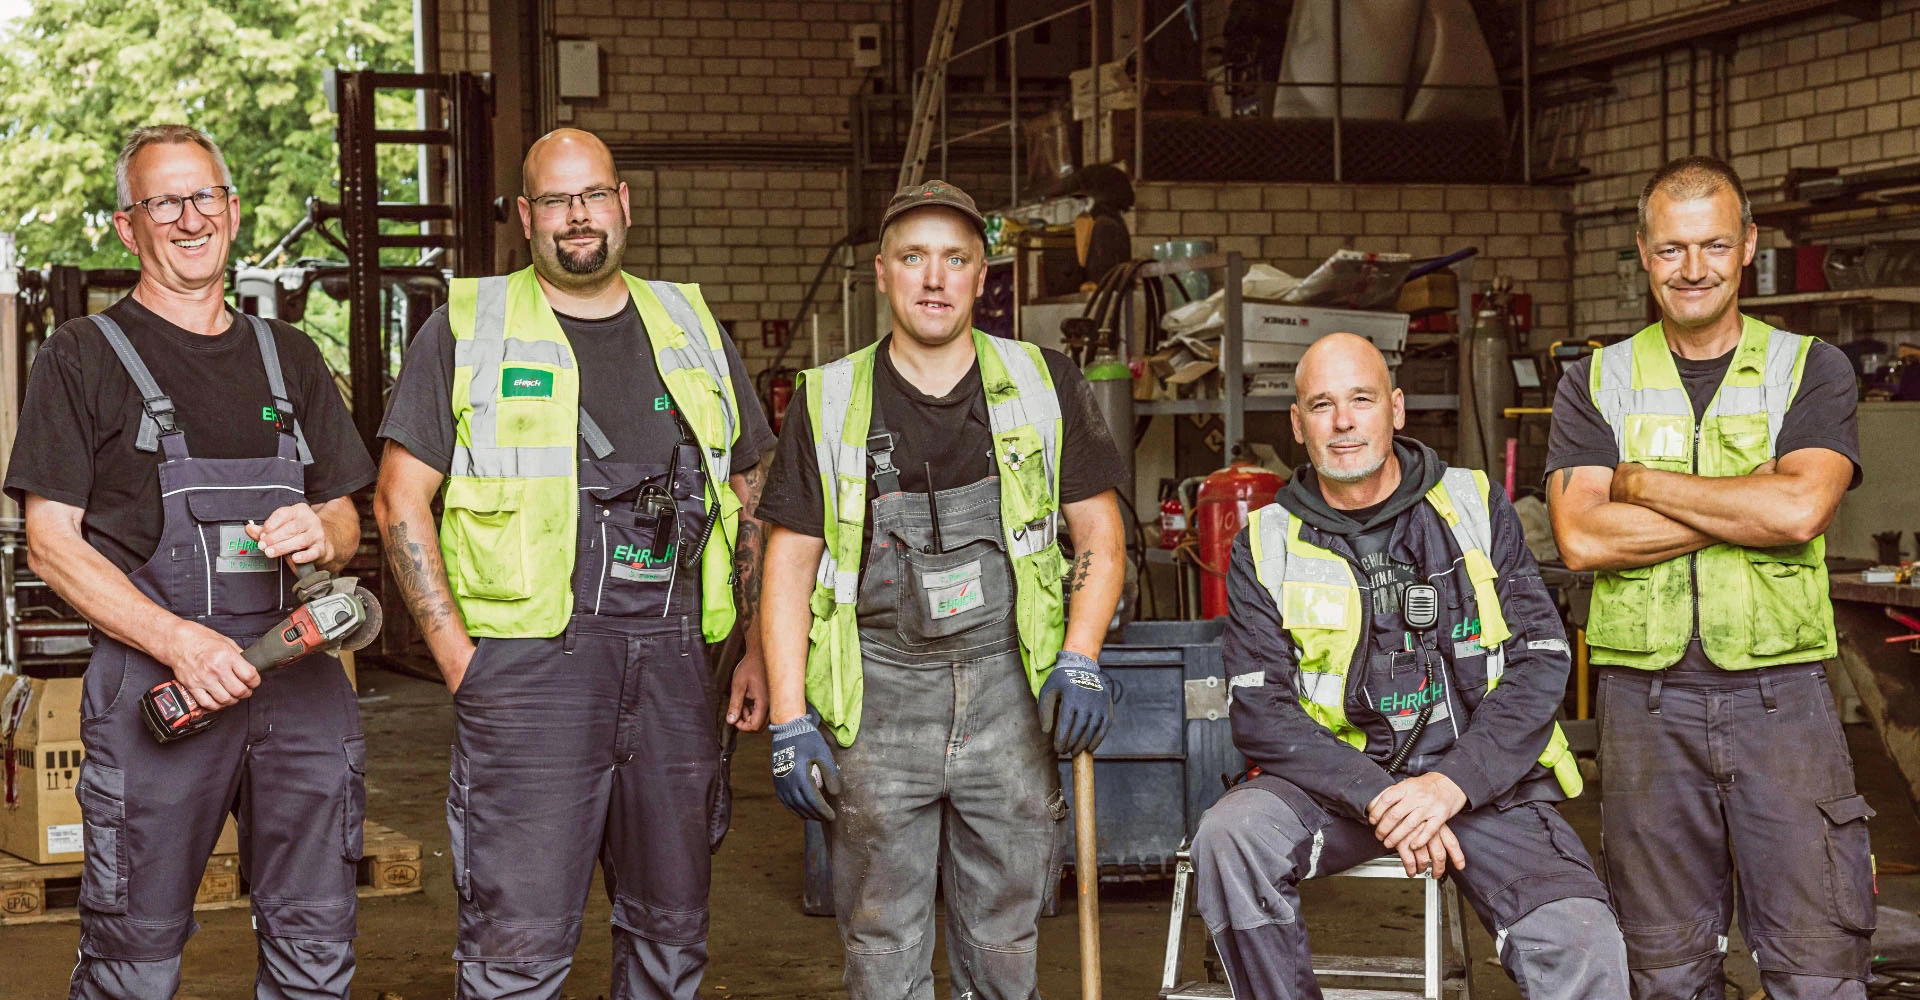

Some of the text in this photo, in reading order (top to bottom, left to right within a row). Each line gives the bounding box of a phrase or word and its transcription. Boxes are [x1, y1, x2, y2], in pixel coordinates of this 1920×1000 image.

[1263, 316, 1297, 326] TEREX
[613, 543, 675, 568] EHRH
[937, 591, 977, 613] EHRICH
[1451, 616, 1481, 639] EHR
[1380, 681, 1443, 712] EHRICH
[7, 897, 34, 909] EPAL
